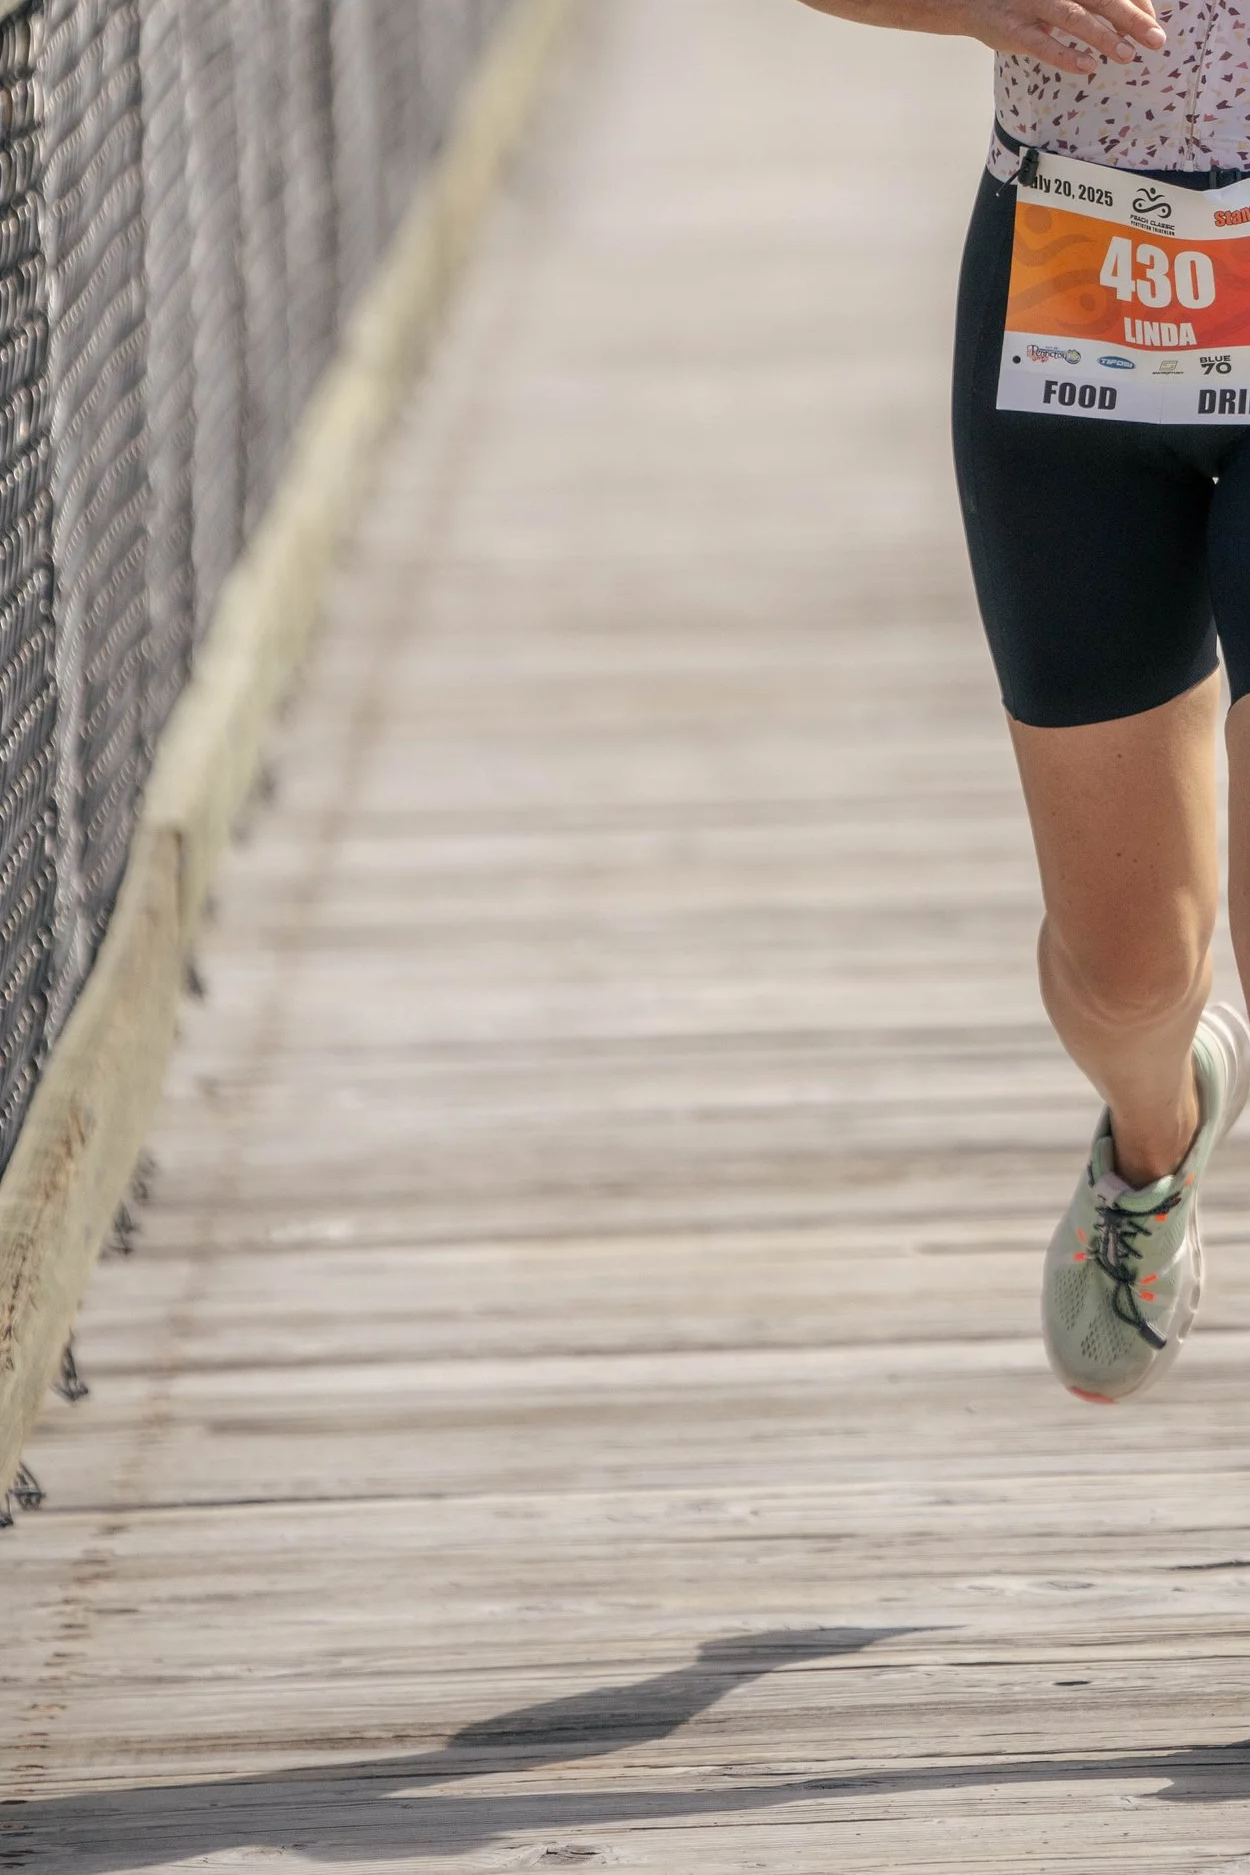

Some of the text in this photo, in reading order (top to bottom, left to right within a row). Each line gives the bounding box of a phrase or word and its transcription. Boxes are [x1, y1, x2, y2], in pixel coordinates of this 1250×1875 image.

[1028, 174, 1114, 207] uly 20, 2025
[1099, 236, 1216, 309] 430
[1123, 316, 1198, 347] LINDA
[1200, 355, 1231, 363] BLUE
[1201, 362, 1232, 376] 70
[1043, 380, 1118, 411] FOOD
